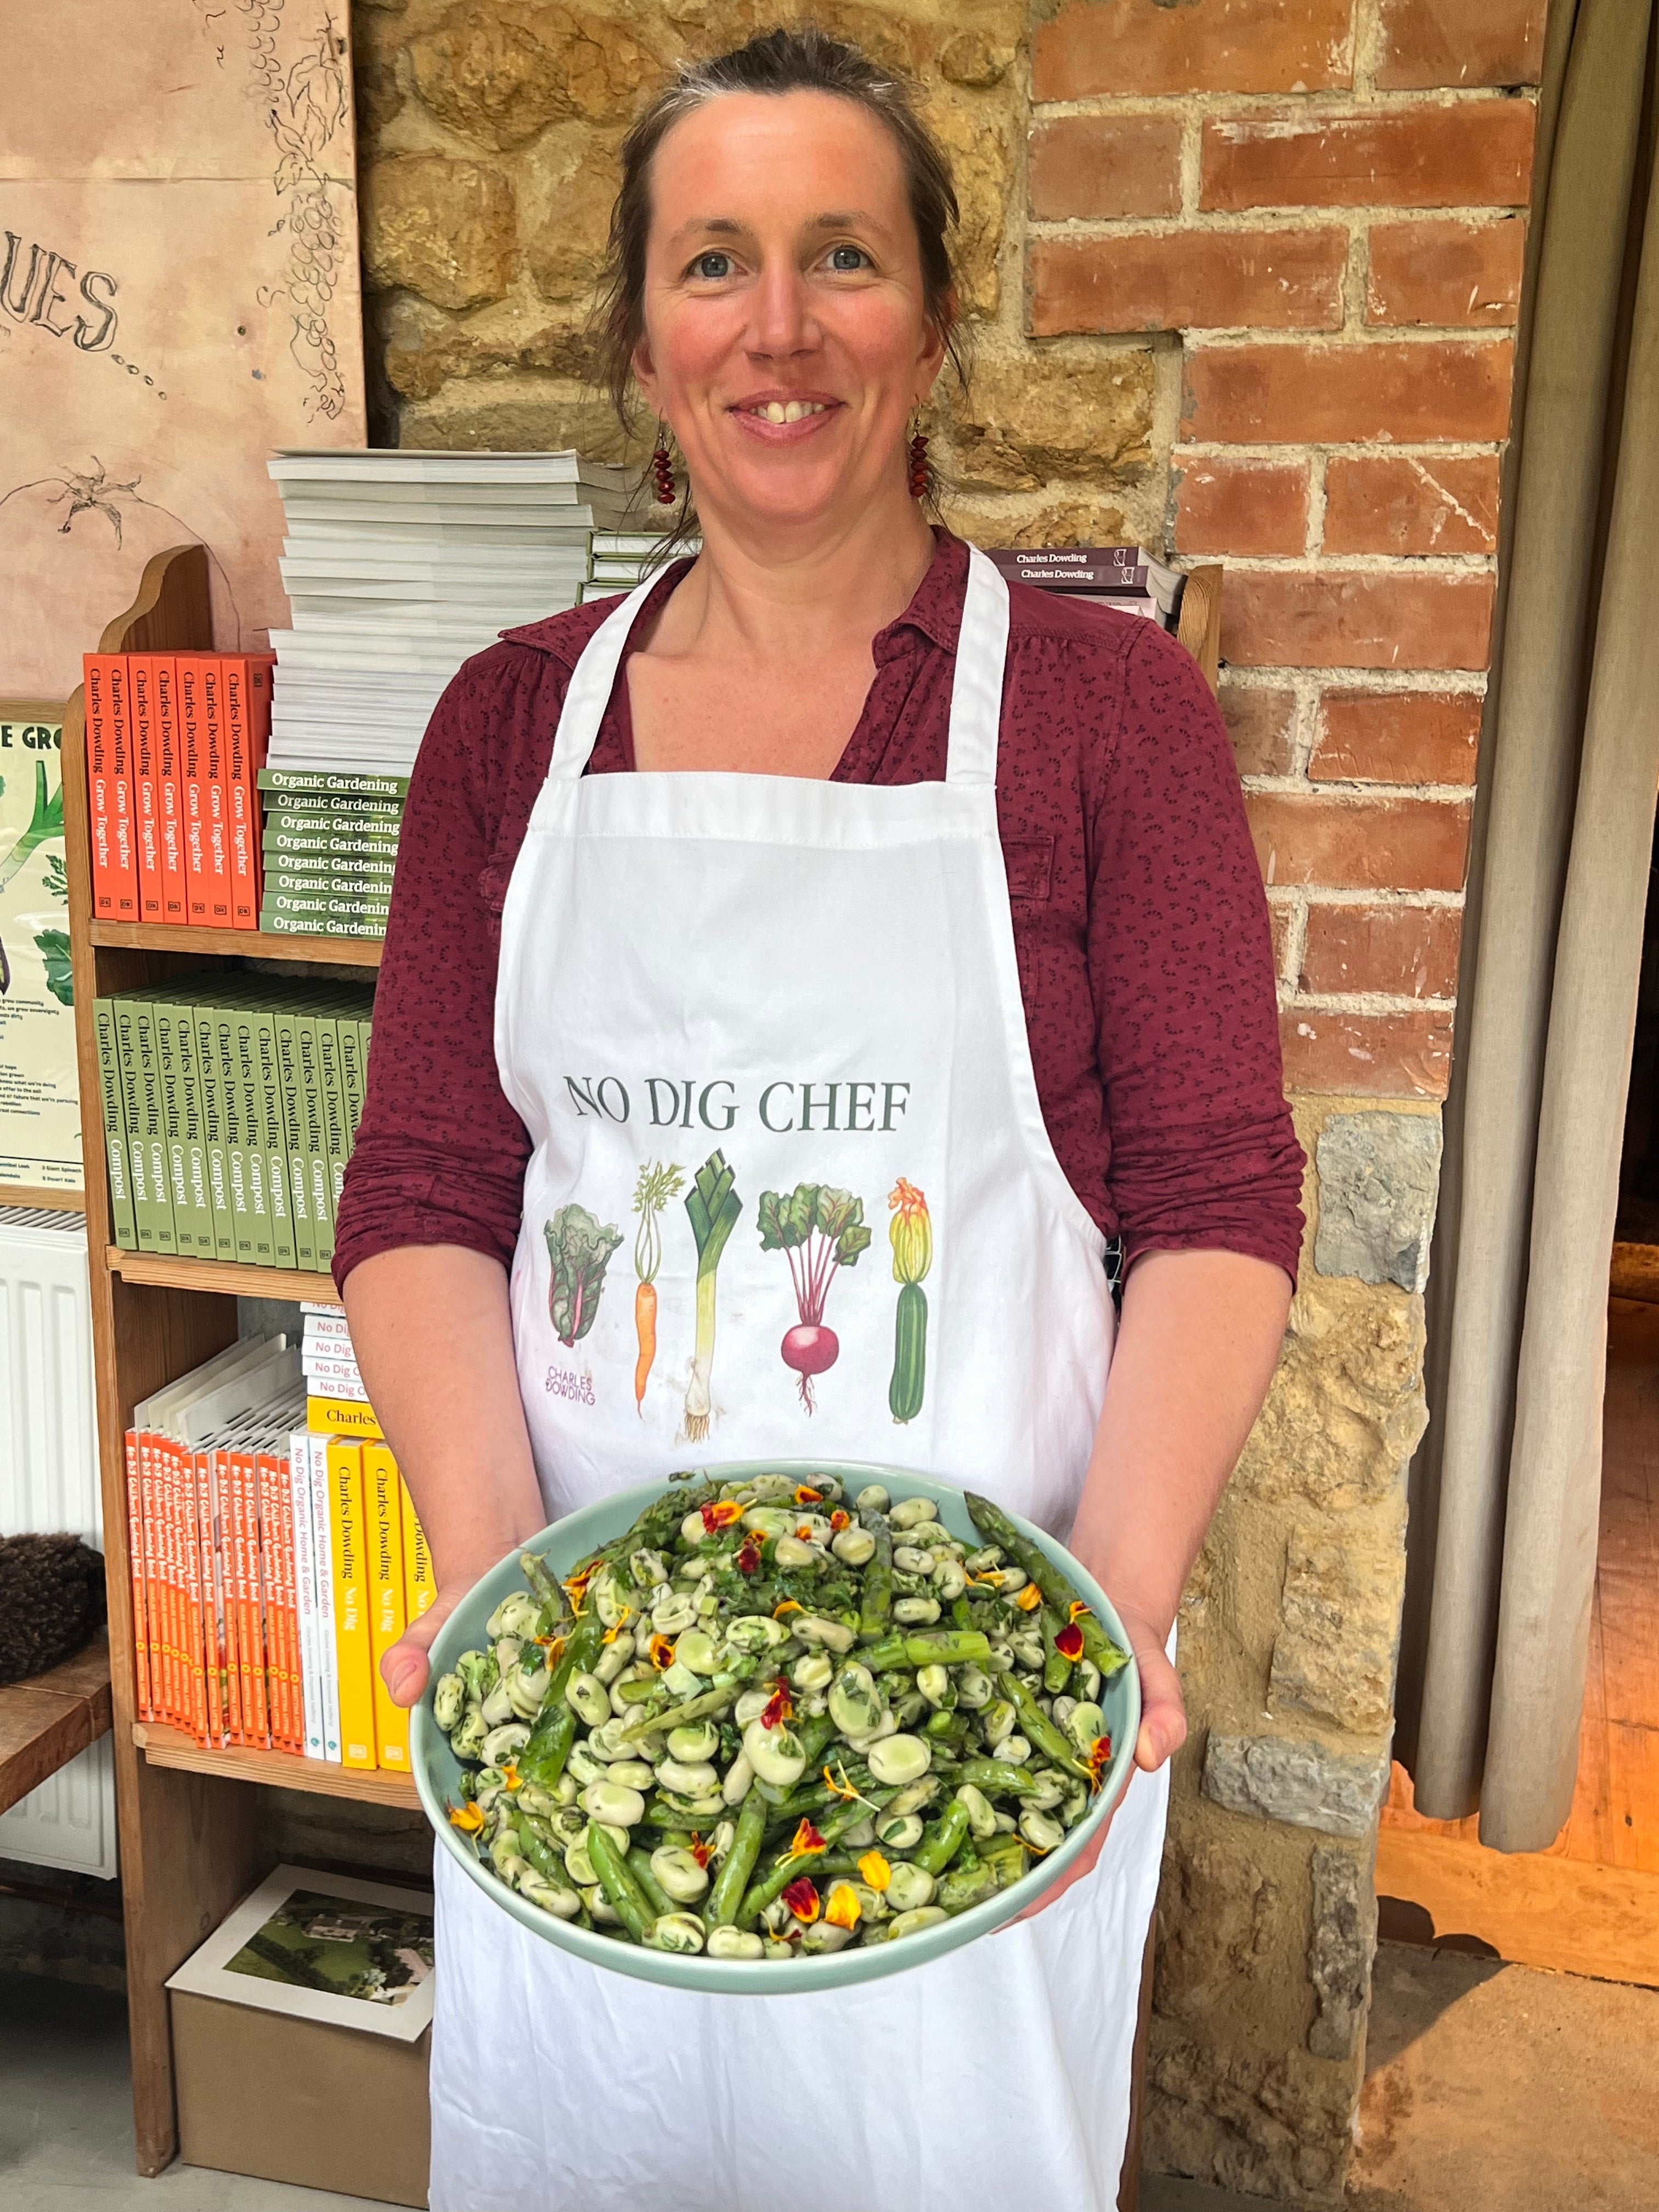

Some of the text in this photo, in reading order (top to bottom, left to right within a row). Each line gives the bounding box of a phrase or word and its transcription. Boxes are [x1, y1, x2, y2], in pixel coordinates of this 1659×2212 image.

[1017, 553, 1087, 563] Charles Dowding
[1021, 569, 1094, 580] Charles Dowding
[91, 669, 109, 867] Charles Dowding Grow Together
[112, 670, 131, 870] Charles Dowding Grow Together
[137, 671, 156, 871] Charles Dowding Grow Together
[160, 671, 178, 872] Charles Dowding Grow Together
[184, 672, 203, 873] Charles Dowding Grow Together
[206, 673, 225, 874] Charles Dowding Grow Together
[230, 674, 248, 876] Charles Dowding Grow Together
[272, 772, 398, 794] Organic Gardening
[276, 834, 398, 856] Organic Gardening
[278, 794, 399, 815] Organic Gardening
[281, 816, 400, 836] Organic Gardening
[273, 917, 324, 932] Organic
[276, 896, 389, 915] Organic Gardenin
[278, 855, 329, 871] Organic
[279, 874, 392, 894] Organic Gardenin
[98, 1013, 126, 1199] Charles Dowding Compost
[120, 1015, 148, 1200] Charles Dowding Compost
[138, 1016, 166, 1202] Charles Dowding Compost
[159, 1018, 187, 1204] Charles Dowding Compost
[179, 1020, 206, 1207] Charles Dowding Compost
[200, 1022, 227, 1209] Charles Dowding Compost
[219, 1024, 246, 1212] Charles Dowding Compost
[238, 1026, 266, 1214] Charles Dowding Compost
[259, 1028, 286, 1217] Charles Dowding Compost
[281, 1029, 307, 1218] Charles Dowding Compost
[301, 1031, 328, 1220] Charles Dowding Compost
[321, 1034, 336, 1086] Charles
[327, 1092, 341, 1154] Dowding
[344, 1035, 357, 1088] Charles
[563, 1076, 910, 1132] NO DIG CHEF
[315, 1341, 351, 1357] No Dig
[315, 1362, 330, 1373] No
[333, 1364, 351, 1378] Dig
[317, 1322, 332, 1333] No
[320, 1381, 335, 1392] No
[337, 1384, 354, 1397] Dig
[545, 1378, 595, 1406] DOWDING
[549, 1365, 592, 1391] CHARLES
[326, 1409, 377, 1426] Charles
[294, 1448, 311, 1615] No Dig Organic Home & Garden
[314, 1451, 329, 1618] No Dig Organic Home & Garden
[340, 1467, 358, 1632] Charles Dowding No Dig
[377, 1469, 395, 1633] Charles Dowding No Dig
